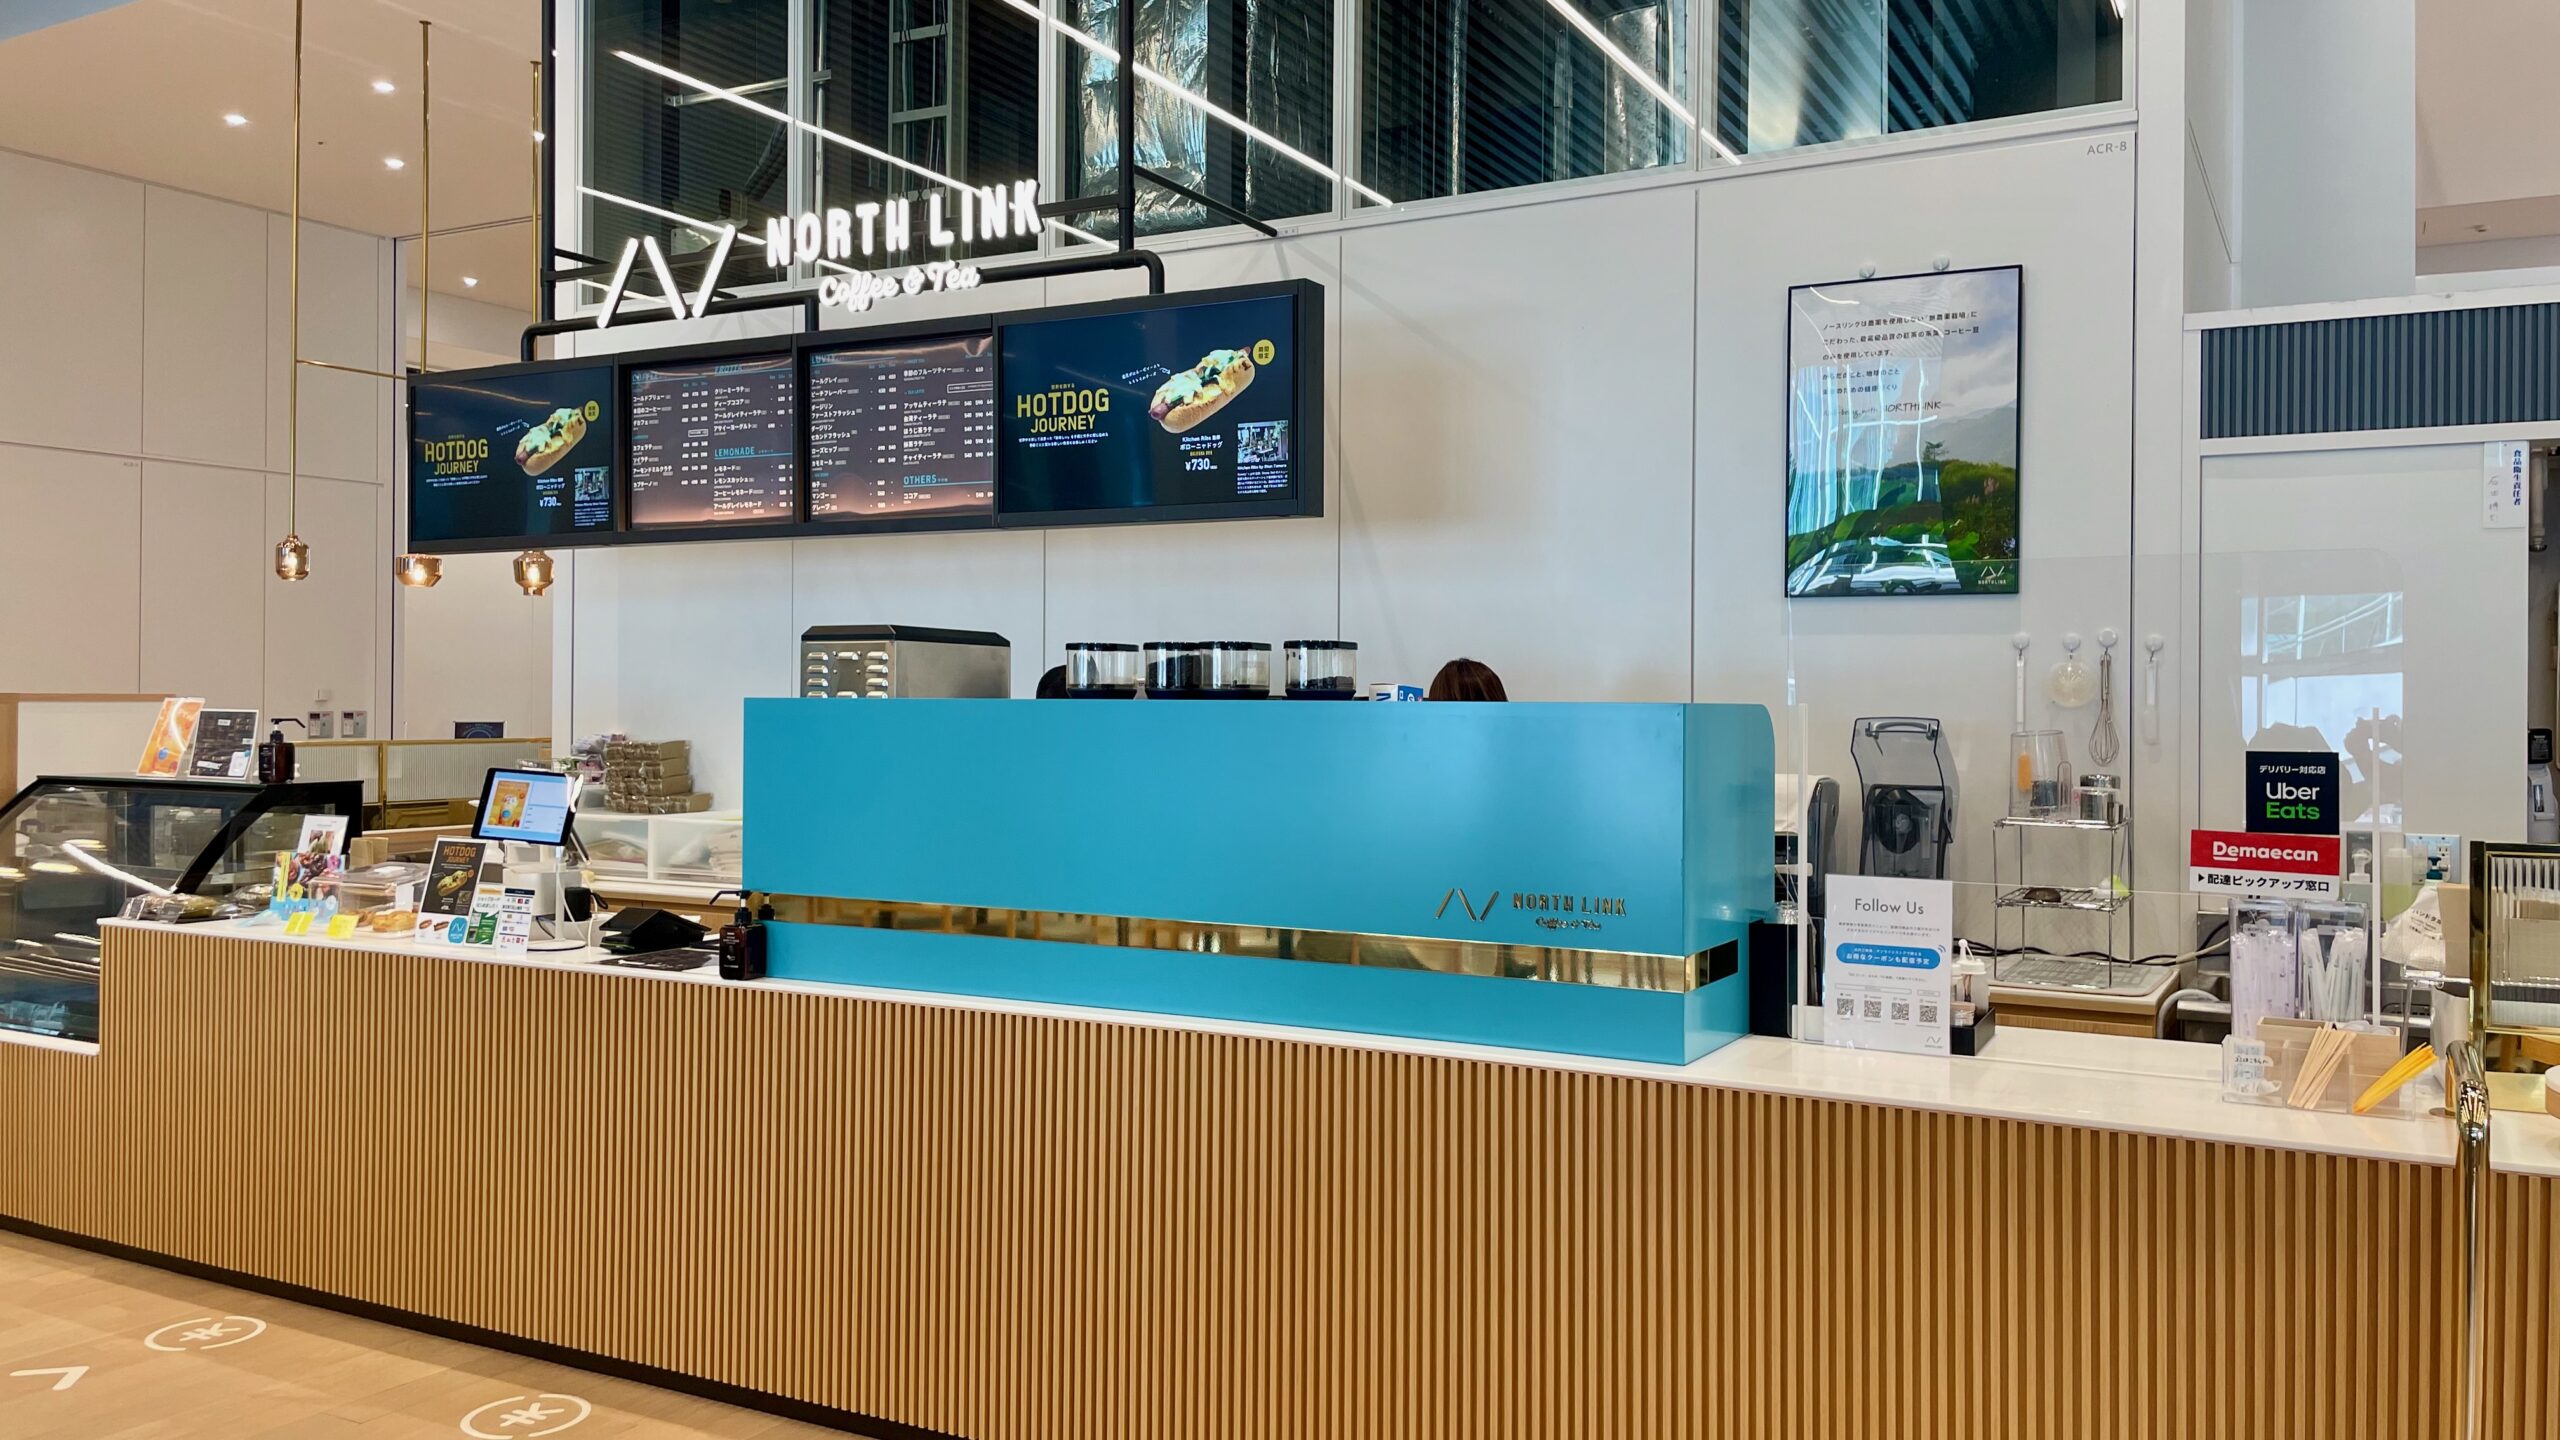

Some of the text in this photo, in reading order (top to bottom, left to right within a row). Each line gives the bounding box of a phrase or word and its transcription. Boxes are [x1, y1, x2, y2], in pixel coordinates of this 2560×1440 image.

[2087, 141, 2127, 155] ACR-8
[766, 178, 1046, 268] NORTH LINK
[818, 270, 901, 313] Coffee
[927, 259, 983, 293] Tea
[811, 376, 837, 385] アールグレイ
[904, 399, 947, 410] アッサムティーラテ
[1017, 388, 1110, 418] HOTDOG
[1883, 401, 1942, 413] ORTHINK
[811, 410, 856, 419] ファーストフラッシュ
[1030, 414, 1096, 434] JOURNEY
[811, 432, 850, 440] セカンドフラッシュ
[903, 426, 932, 435] ほうじ茶ラテ
[424, 439, 488, 463] HOTDOG
[714, 447, 755, 457] LEMONADE
[811, 446, 837, 454] ローズヒップ
[903, 452, 942, 461] チャイティーラテ
[434, 461, 479, 475] JOURNEY
[1185, 458, 1210, 471] ¥730
[903, 474, 937, 485] OTHERS
[714, 489, 753, 497] コーヒーレモネード
[903, 492, 918, 500] ココア
[539, 497, 557, 507] ¥730
[713, 501, 762, 509] アールグレイレモネード
[2258, 765, 2327, 775] デリバリー対応店
[2265, 781, 2320, 800] Uber
[2265, 802, 2321, 820] Eats
[2213, 841, 2319, 863] Demaecan
[2206, 873, 2330, 892] 配達ピックアップ窓口
[1513, 892, 1627, 917] NORTH LINK
[1854, 898, 1925, 915] Follow Us
